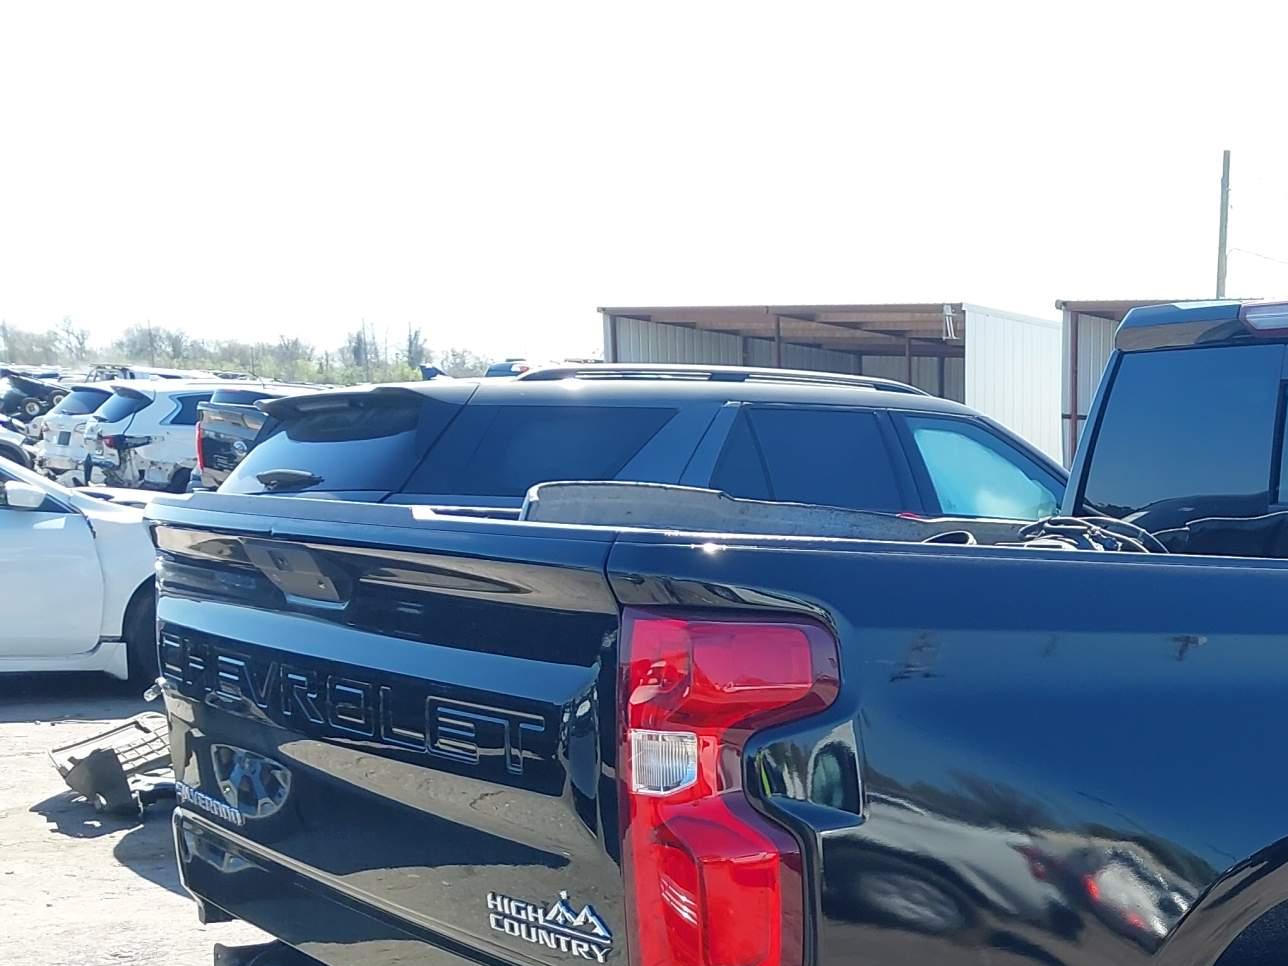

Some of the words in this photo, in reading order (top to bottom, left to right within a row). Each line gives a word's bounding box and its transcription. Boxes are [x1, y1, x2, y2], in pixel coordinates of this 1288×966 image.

[161, 631, 545, 775] CHEVROLET
[486, 892, 545, 925] HIGH
[489, 912, 612, 964] COUNTRY
